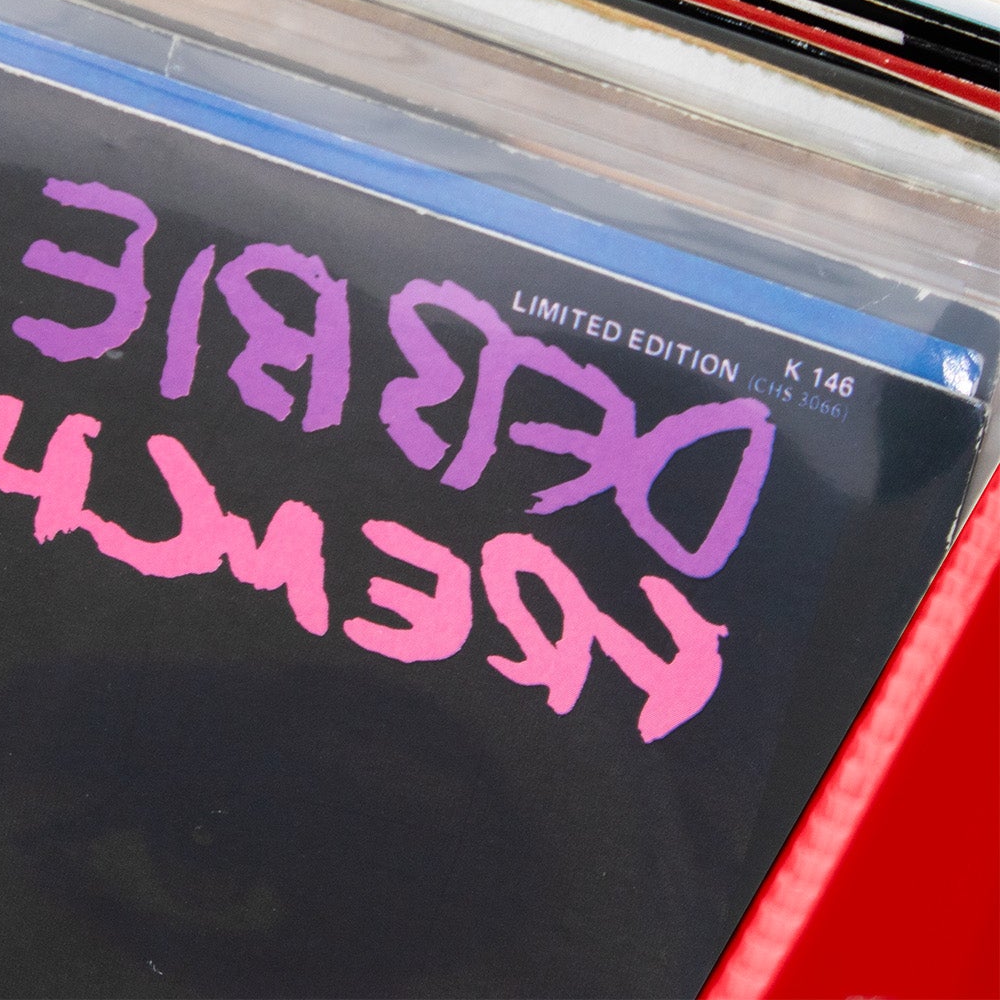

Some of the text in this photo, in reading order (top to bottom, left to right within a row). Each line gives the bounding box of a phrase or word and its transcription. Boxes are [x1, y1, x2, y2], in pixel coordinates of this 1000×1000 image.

[511, 290, 740, 383] LIMITED EDITION
[747, 374, 850, 424] (CHS 3066)
[784, 358, 855, 398] K 146
